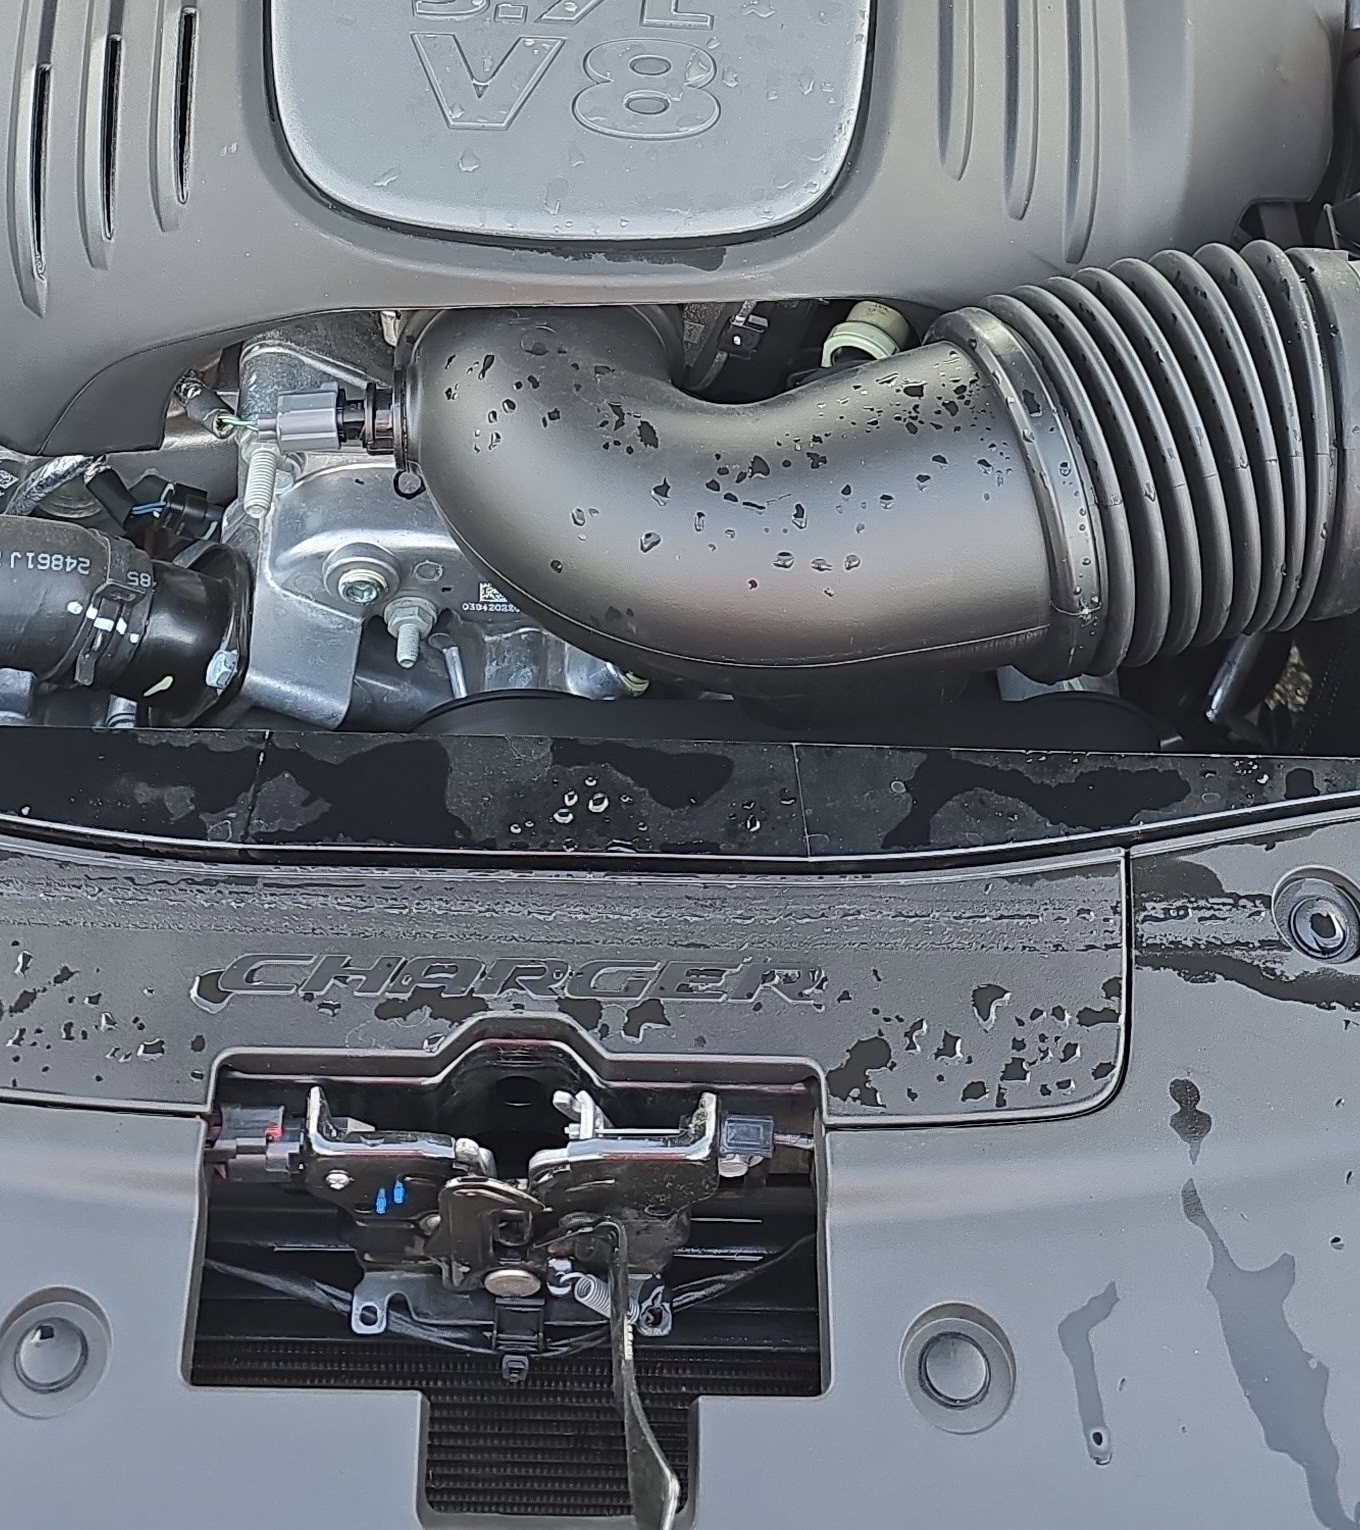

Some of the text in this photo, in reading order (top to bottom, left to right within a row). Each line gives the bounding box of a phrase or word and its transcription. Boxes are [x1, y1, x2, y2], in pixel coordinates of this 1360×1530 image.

[408, 31, 722, 141] V8
[9, 551, 91, 575] 24861J
[216, 953, 828, 1007] CHARGER
